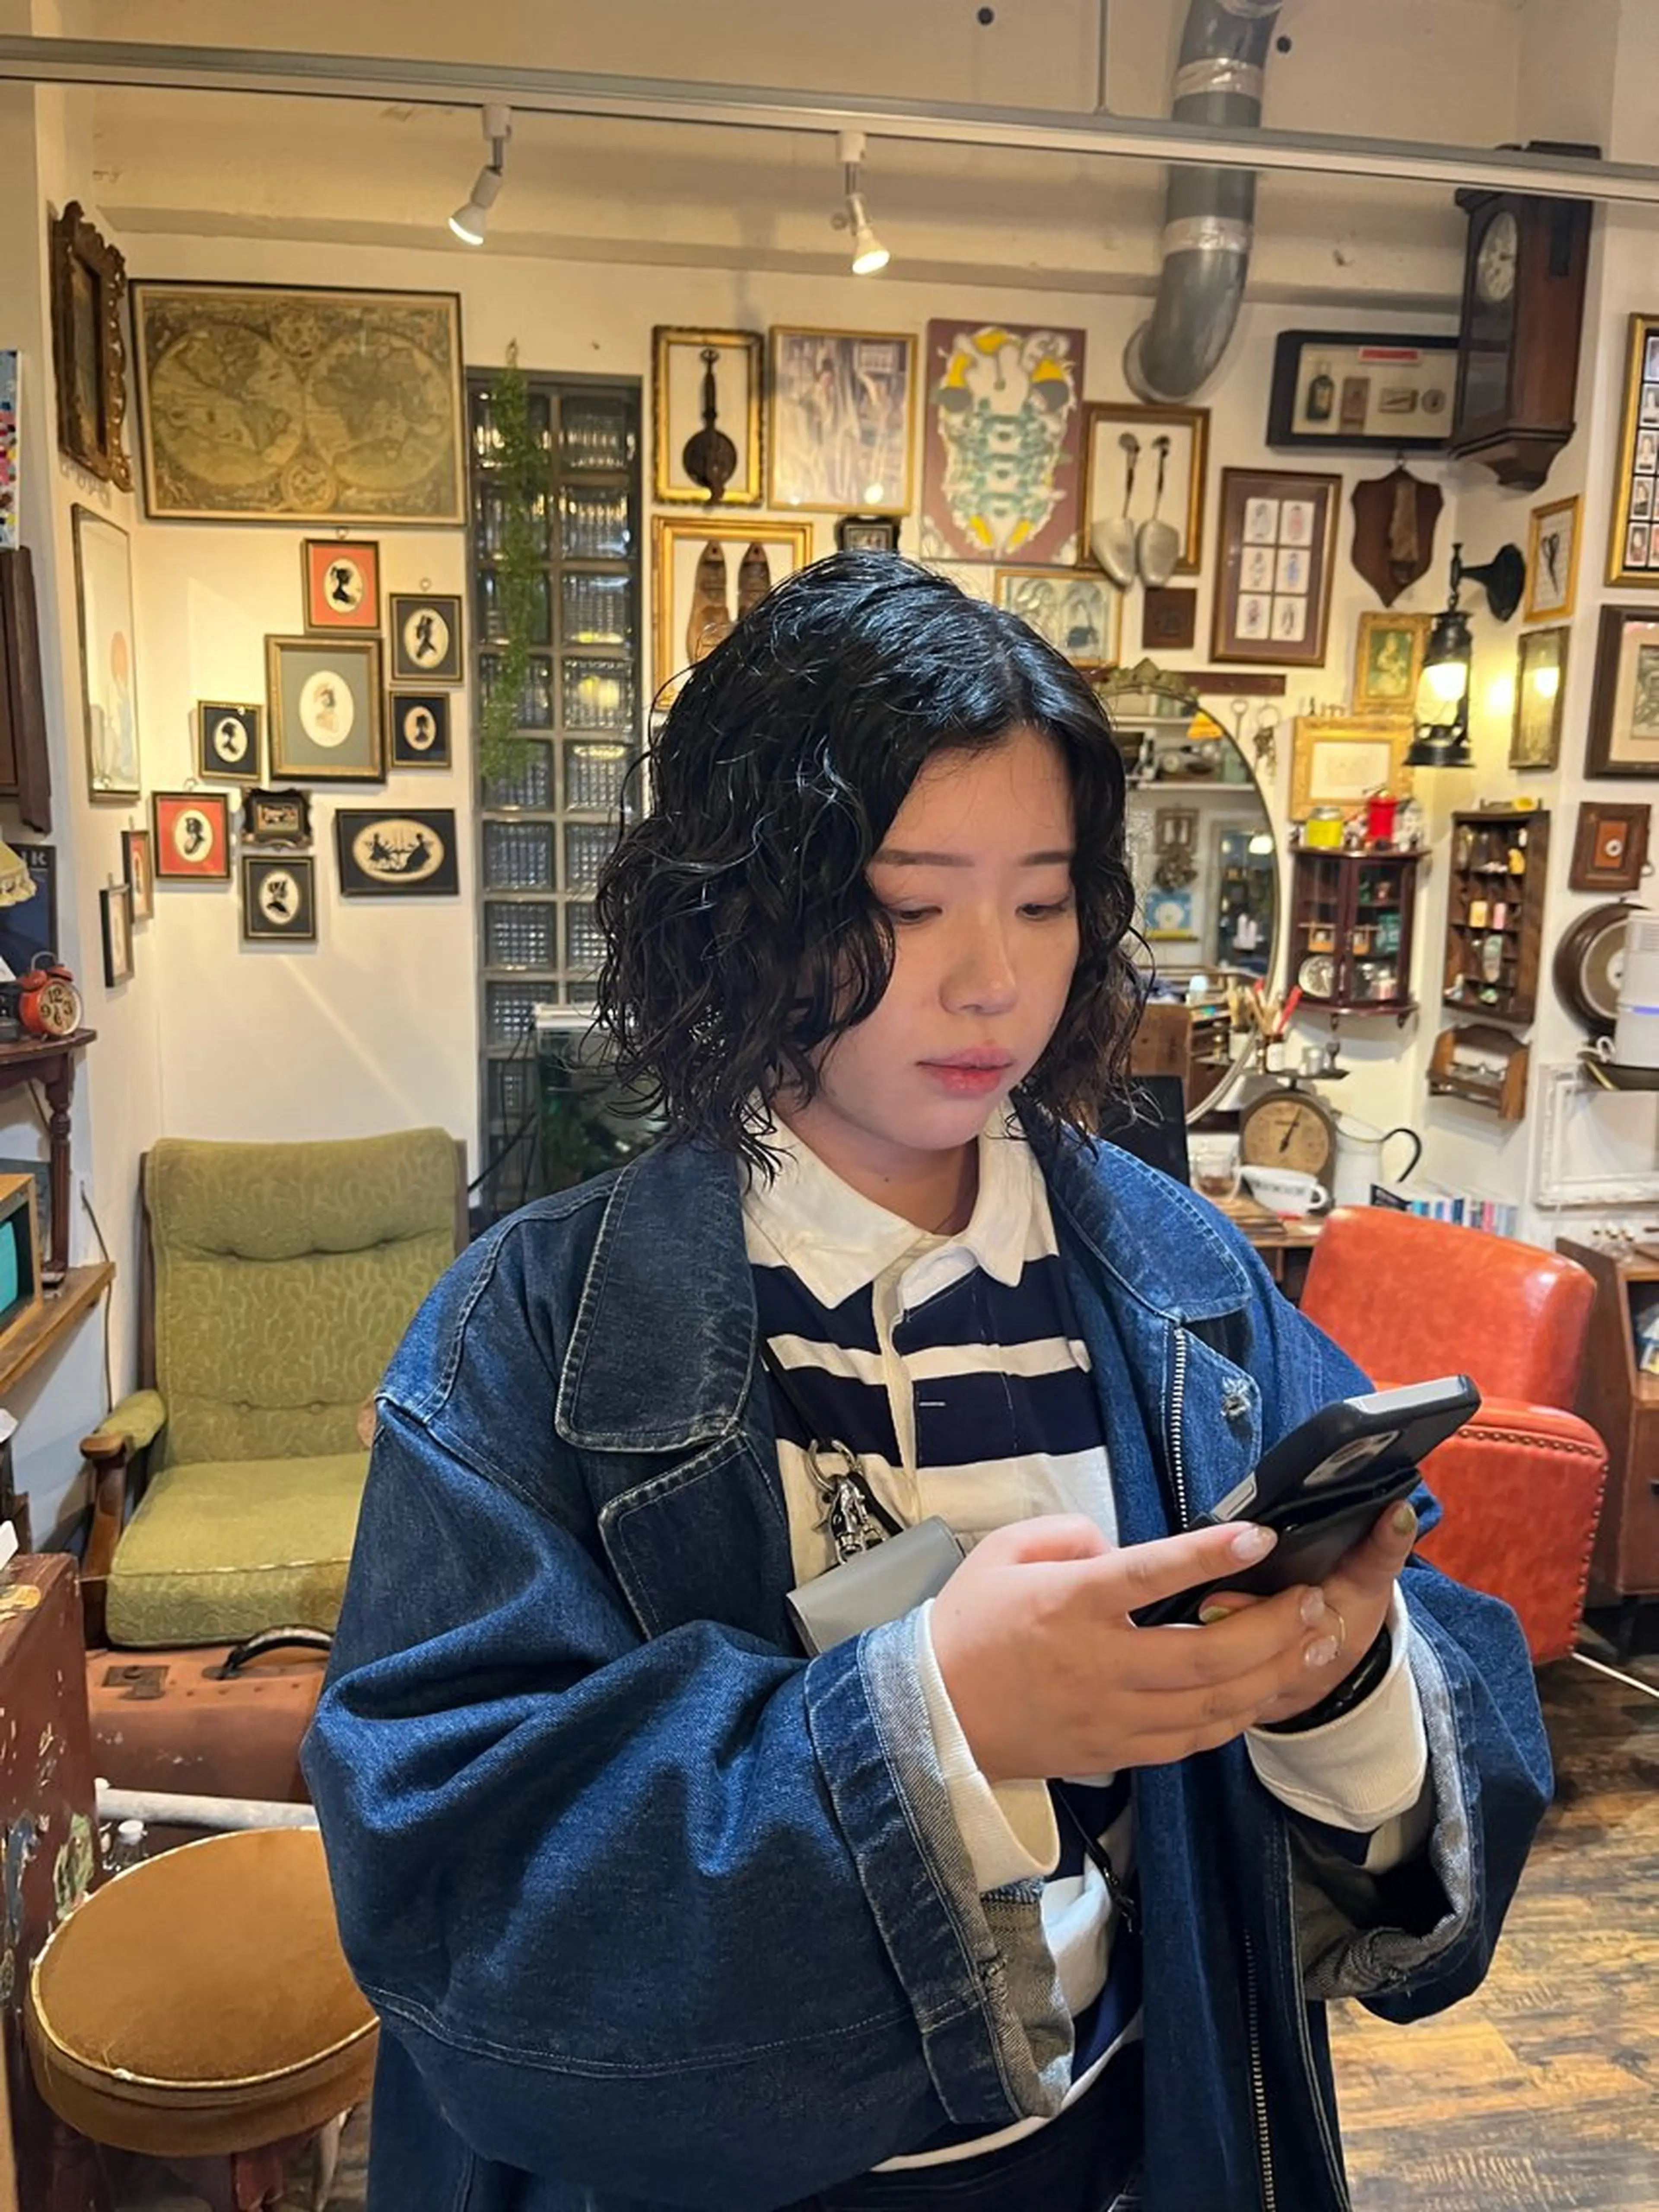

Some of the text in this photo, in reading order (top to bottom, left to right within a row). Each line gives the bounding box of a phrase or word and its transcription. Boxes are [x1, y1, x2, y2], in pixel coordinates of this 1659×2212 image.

[48, 987, 63, 1004] 12
[41, 1004, 51, 1018] 9
[64, 1000, 73, 1015] 3
[54, 1008, 62, 1026] 6
